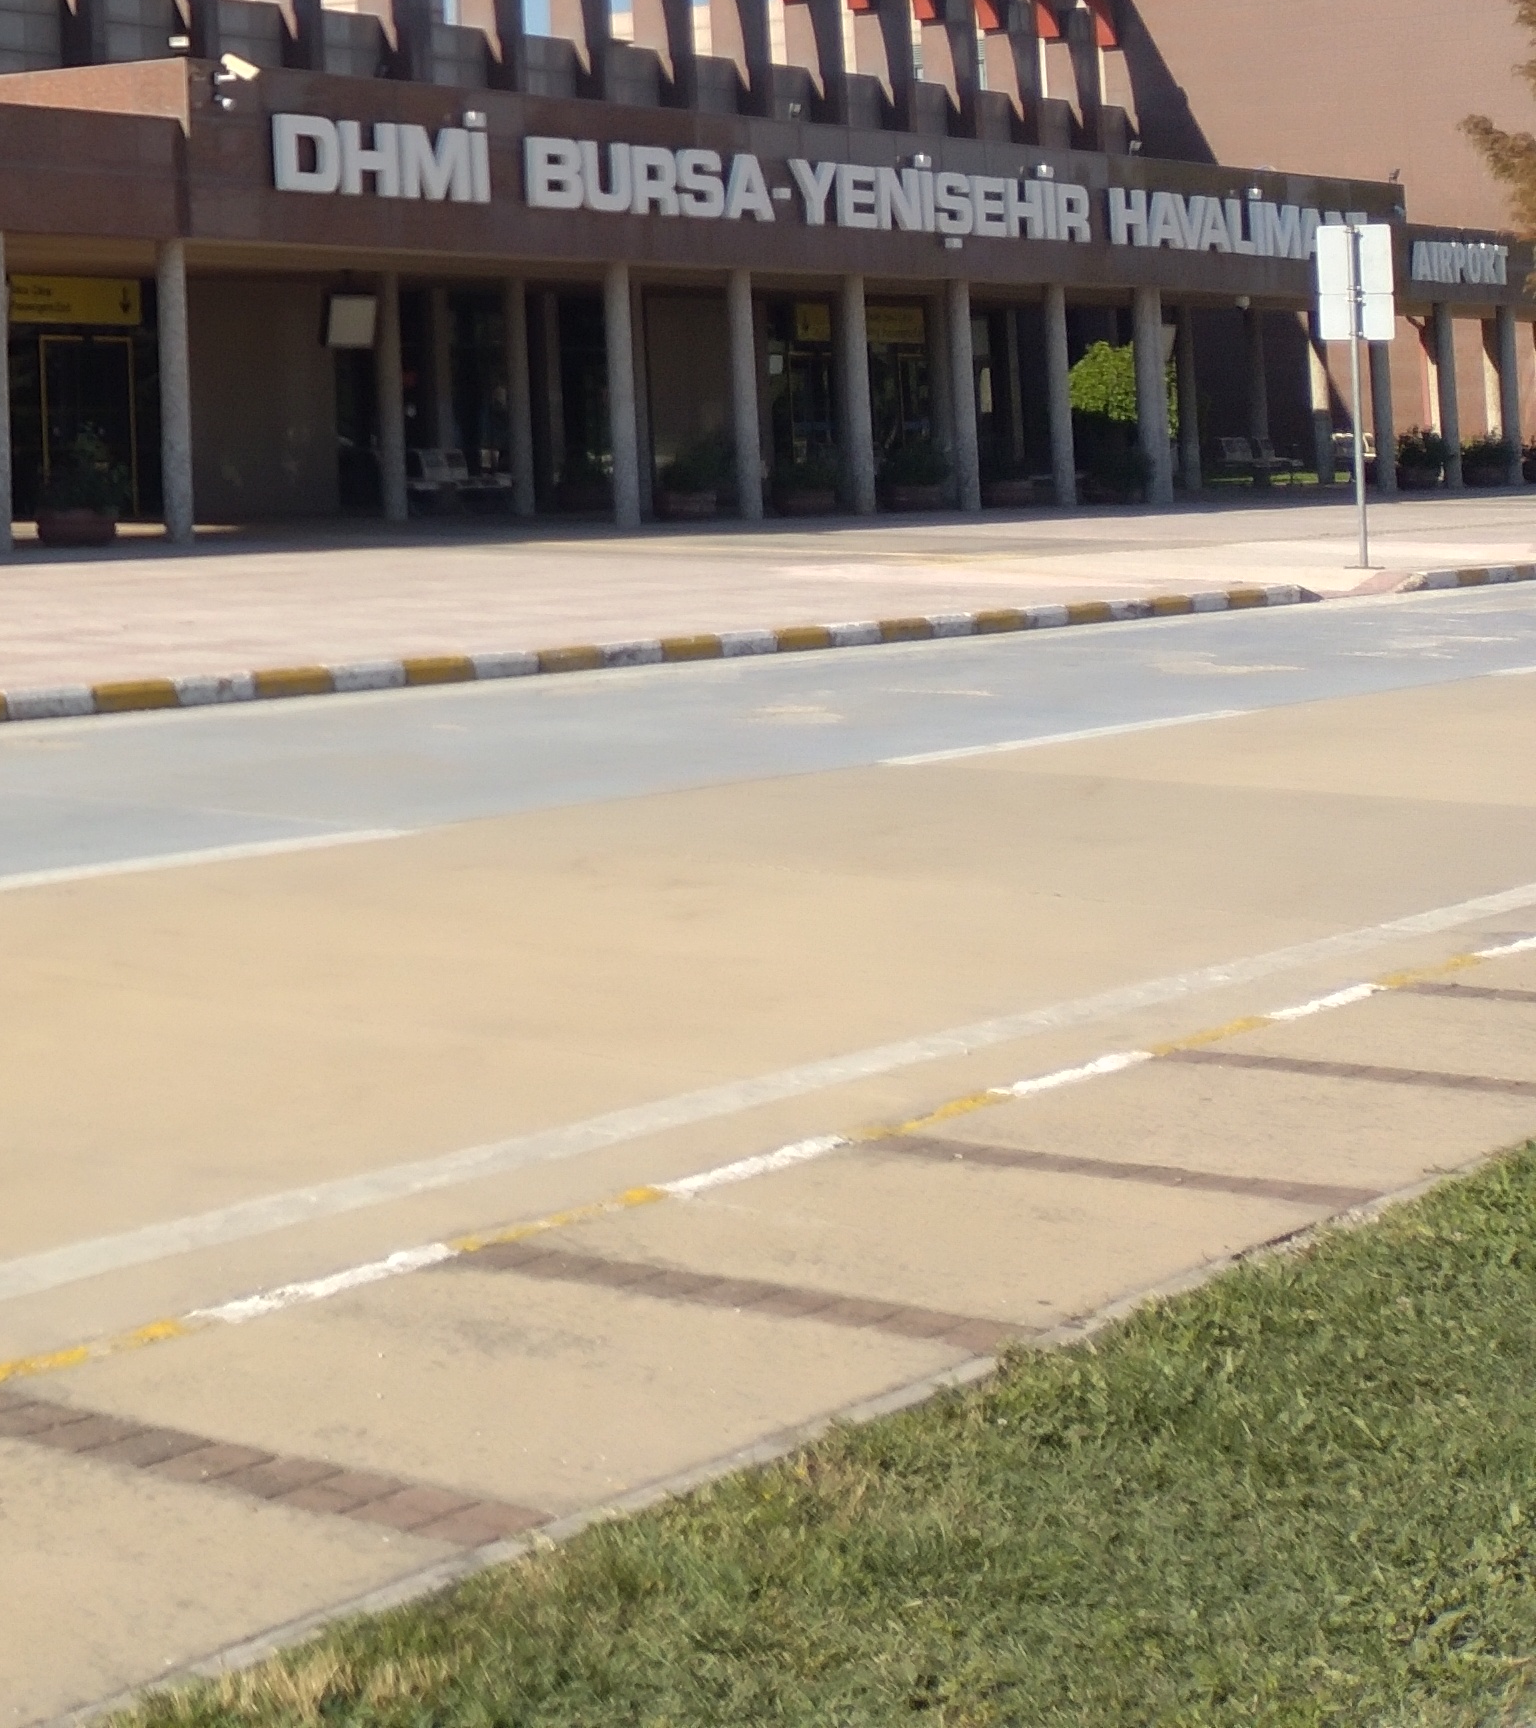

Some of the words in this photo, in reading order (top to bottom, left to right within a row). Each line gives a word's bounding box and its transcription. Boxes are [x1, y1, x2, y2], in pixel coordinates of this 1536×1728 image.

[272, 111, 491, 203] DHMİ
[524, 136, 1091, 249] BURSA-YENİŞEHİR
[1109, 186, 1369, 261] HAVALİMA
[1411, 240, 1509, 286] AIRPORT
